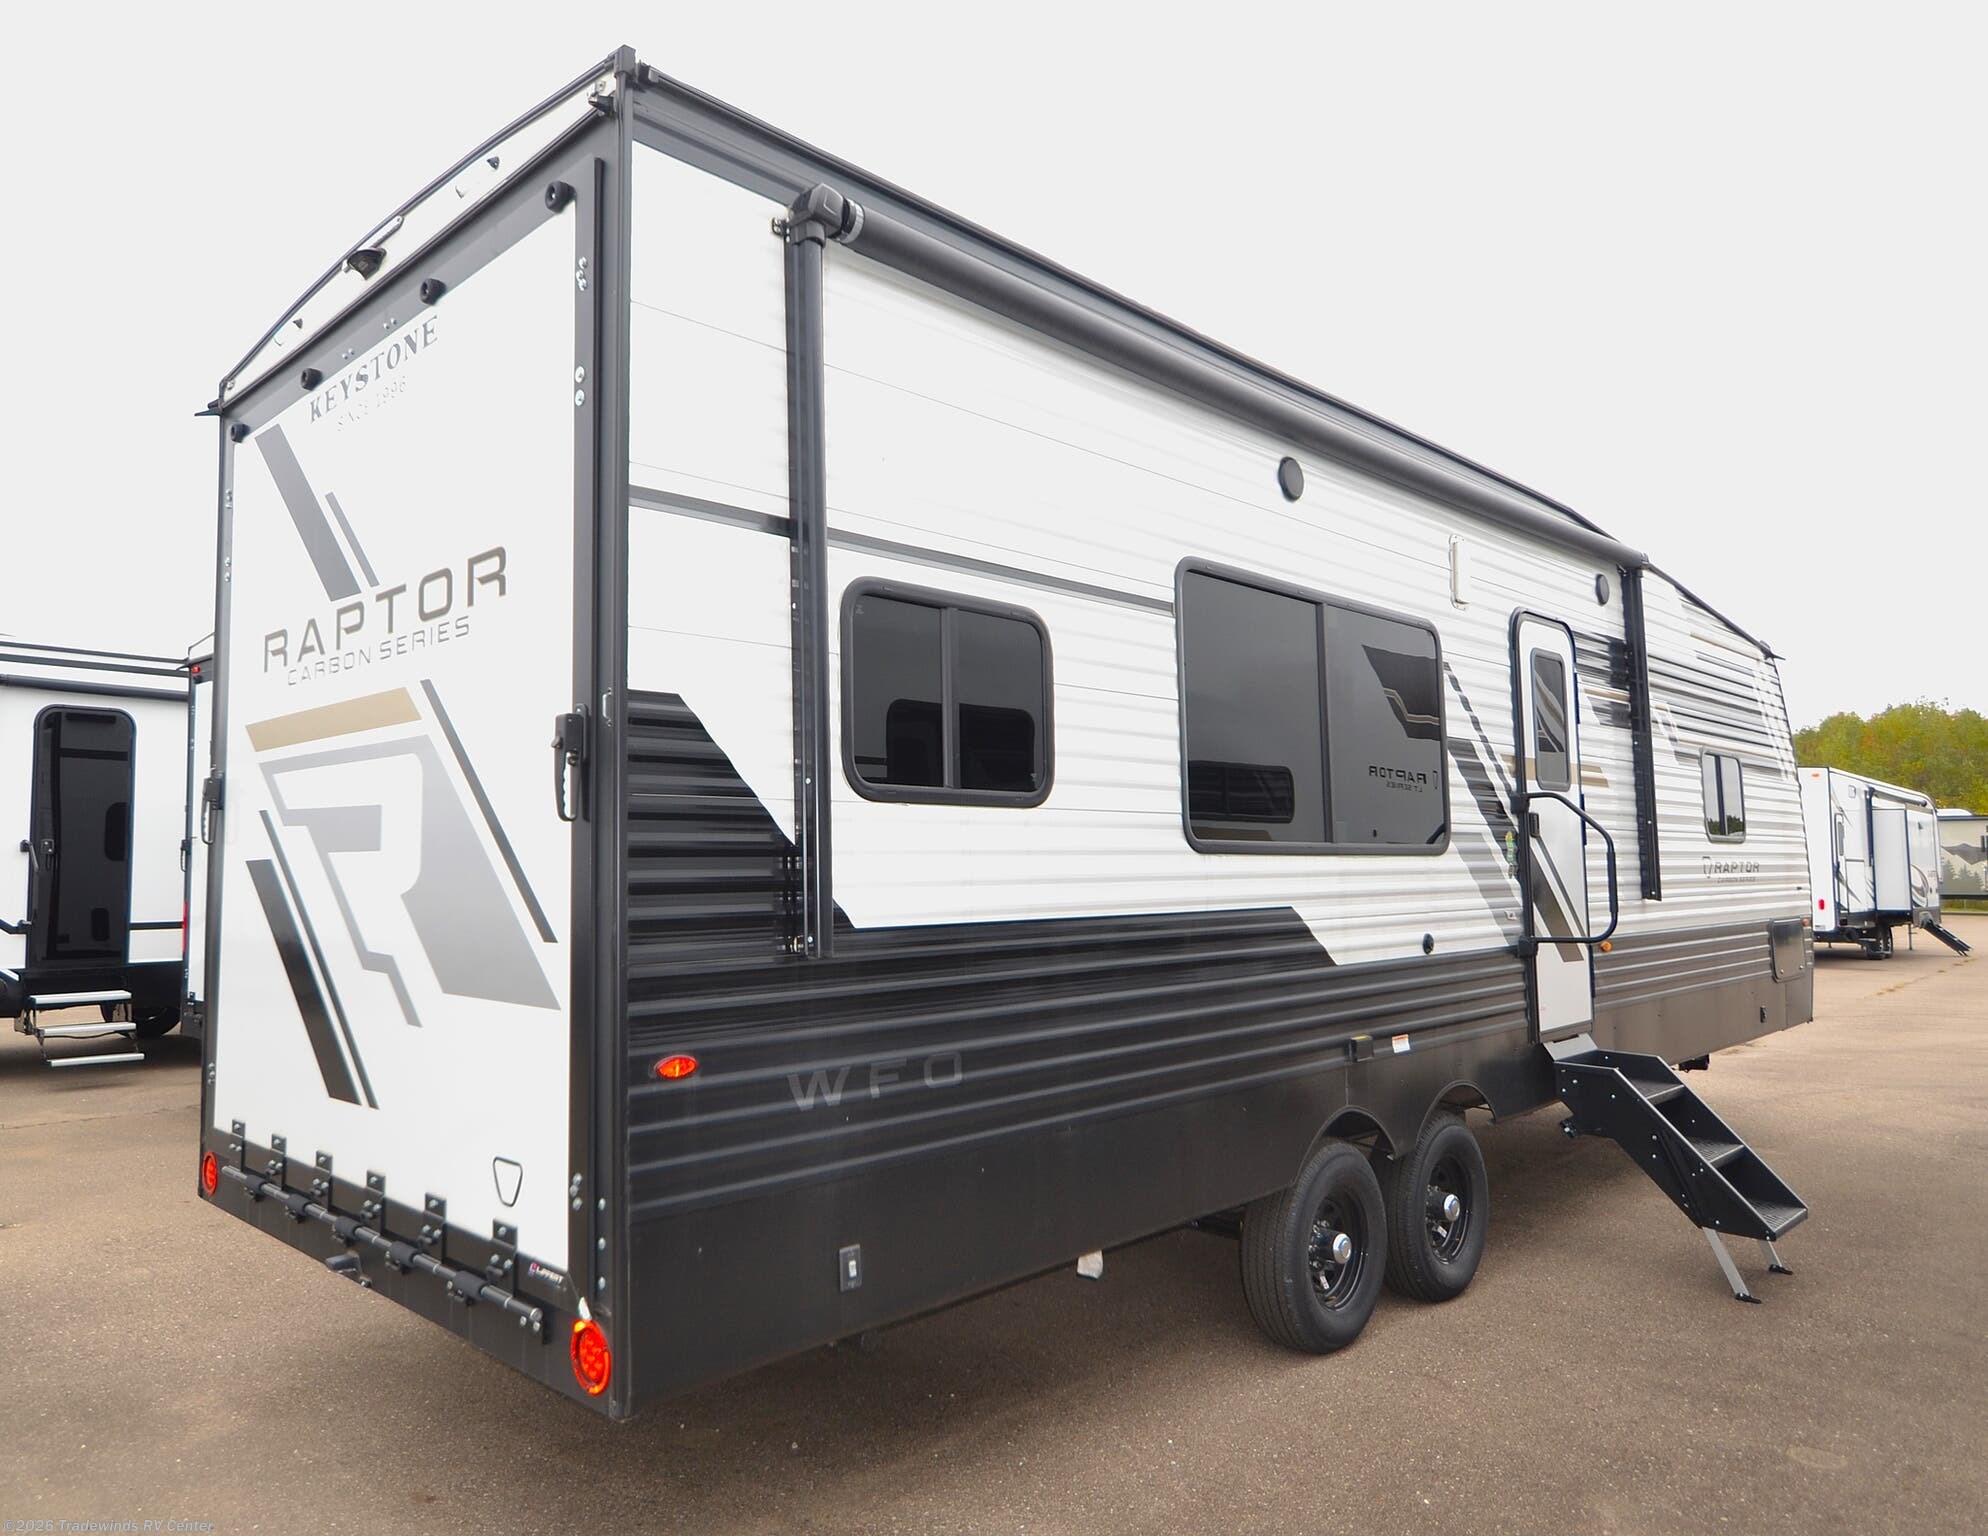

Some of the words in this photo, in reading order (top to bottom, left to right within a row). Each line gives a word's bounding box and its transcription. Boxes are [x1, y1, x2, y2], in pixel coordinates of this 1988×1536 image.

[310, 315, 438, 424] KEYSTONE
[263, 545, 507, 673] RAPTOR
[287, 648, 372, 687] CARBON
[378, 615, 471, 662] SERIES
[1714, 861, 1760, 874] RAPTOR
[787, 1052, 962, 1112] WFO
